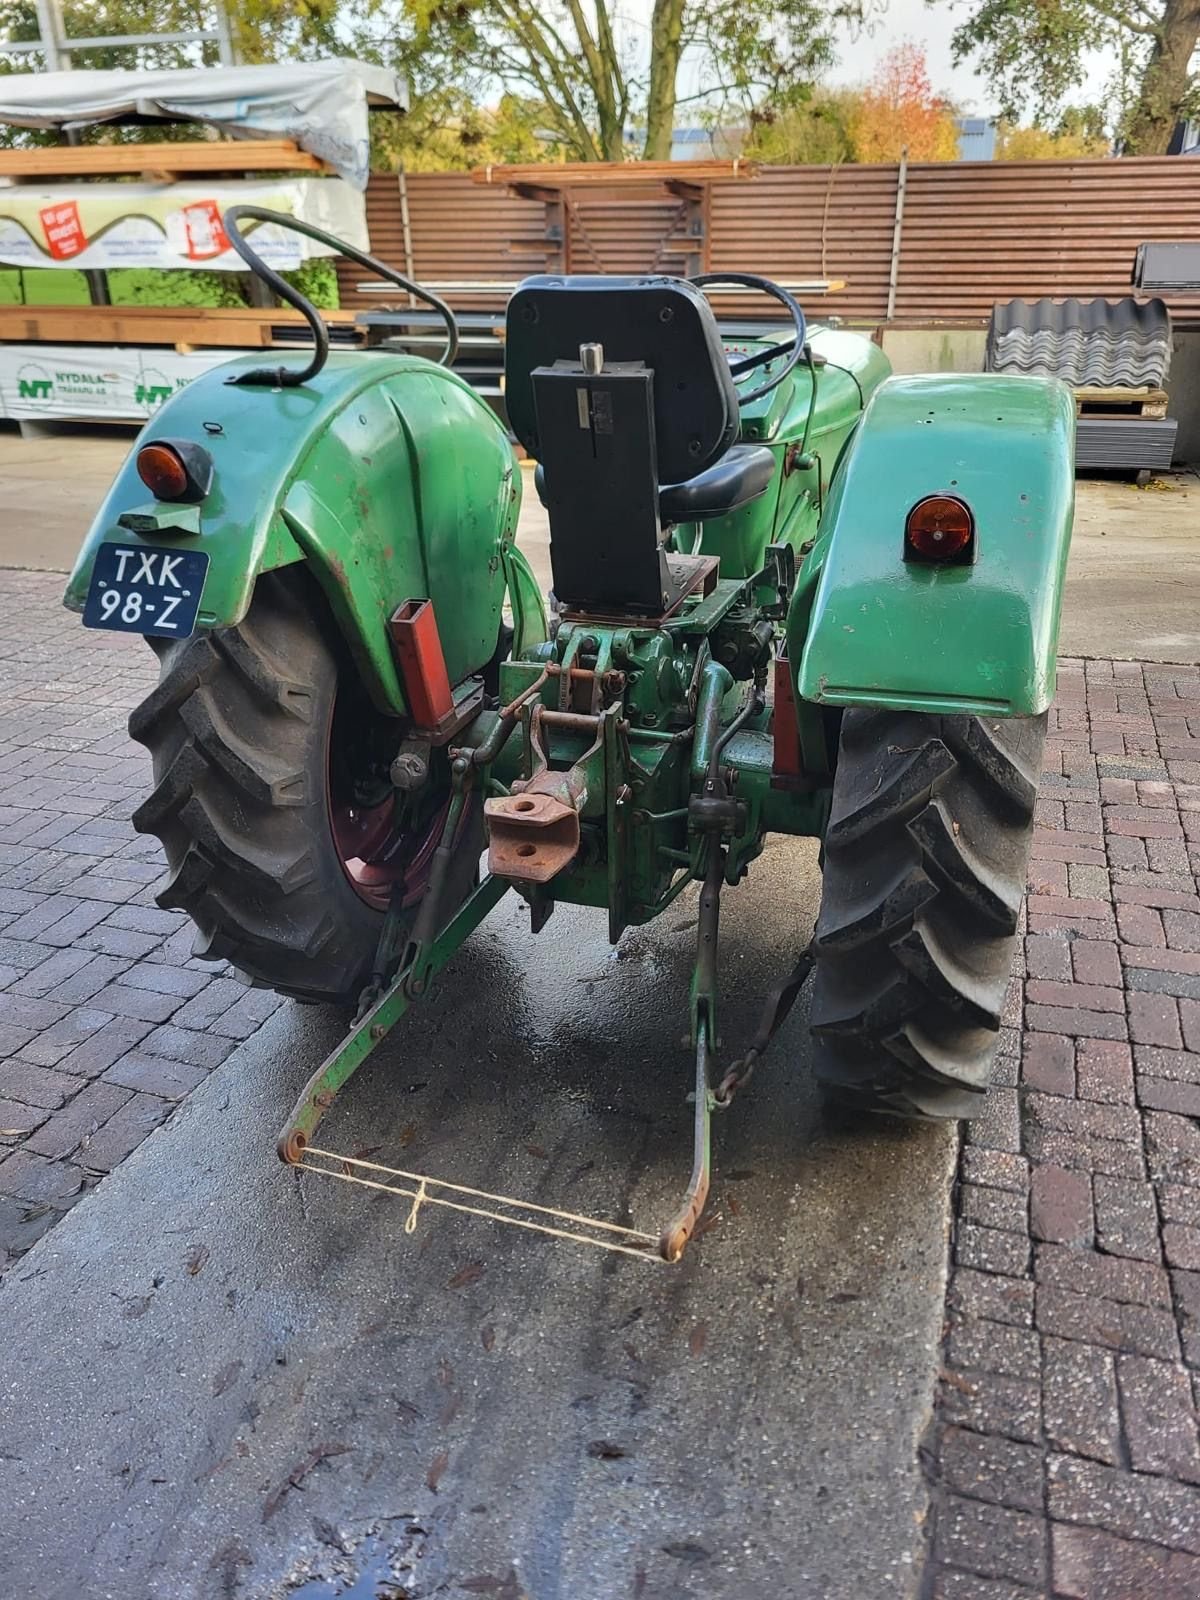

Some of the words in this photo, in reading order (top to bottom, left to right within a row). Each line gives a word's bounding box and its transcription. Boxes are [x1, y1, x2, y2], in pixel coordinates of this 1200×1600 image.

[18, 379, 53, 398] NT
[115, 549, 184, 588] TXK
[100, 589, 182, 629] 98-Z
